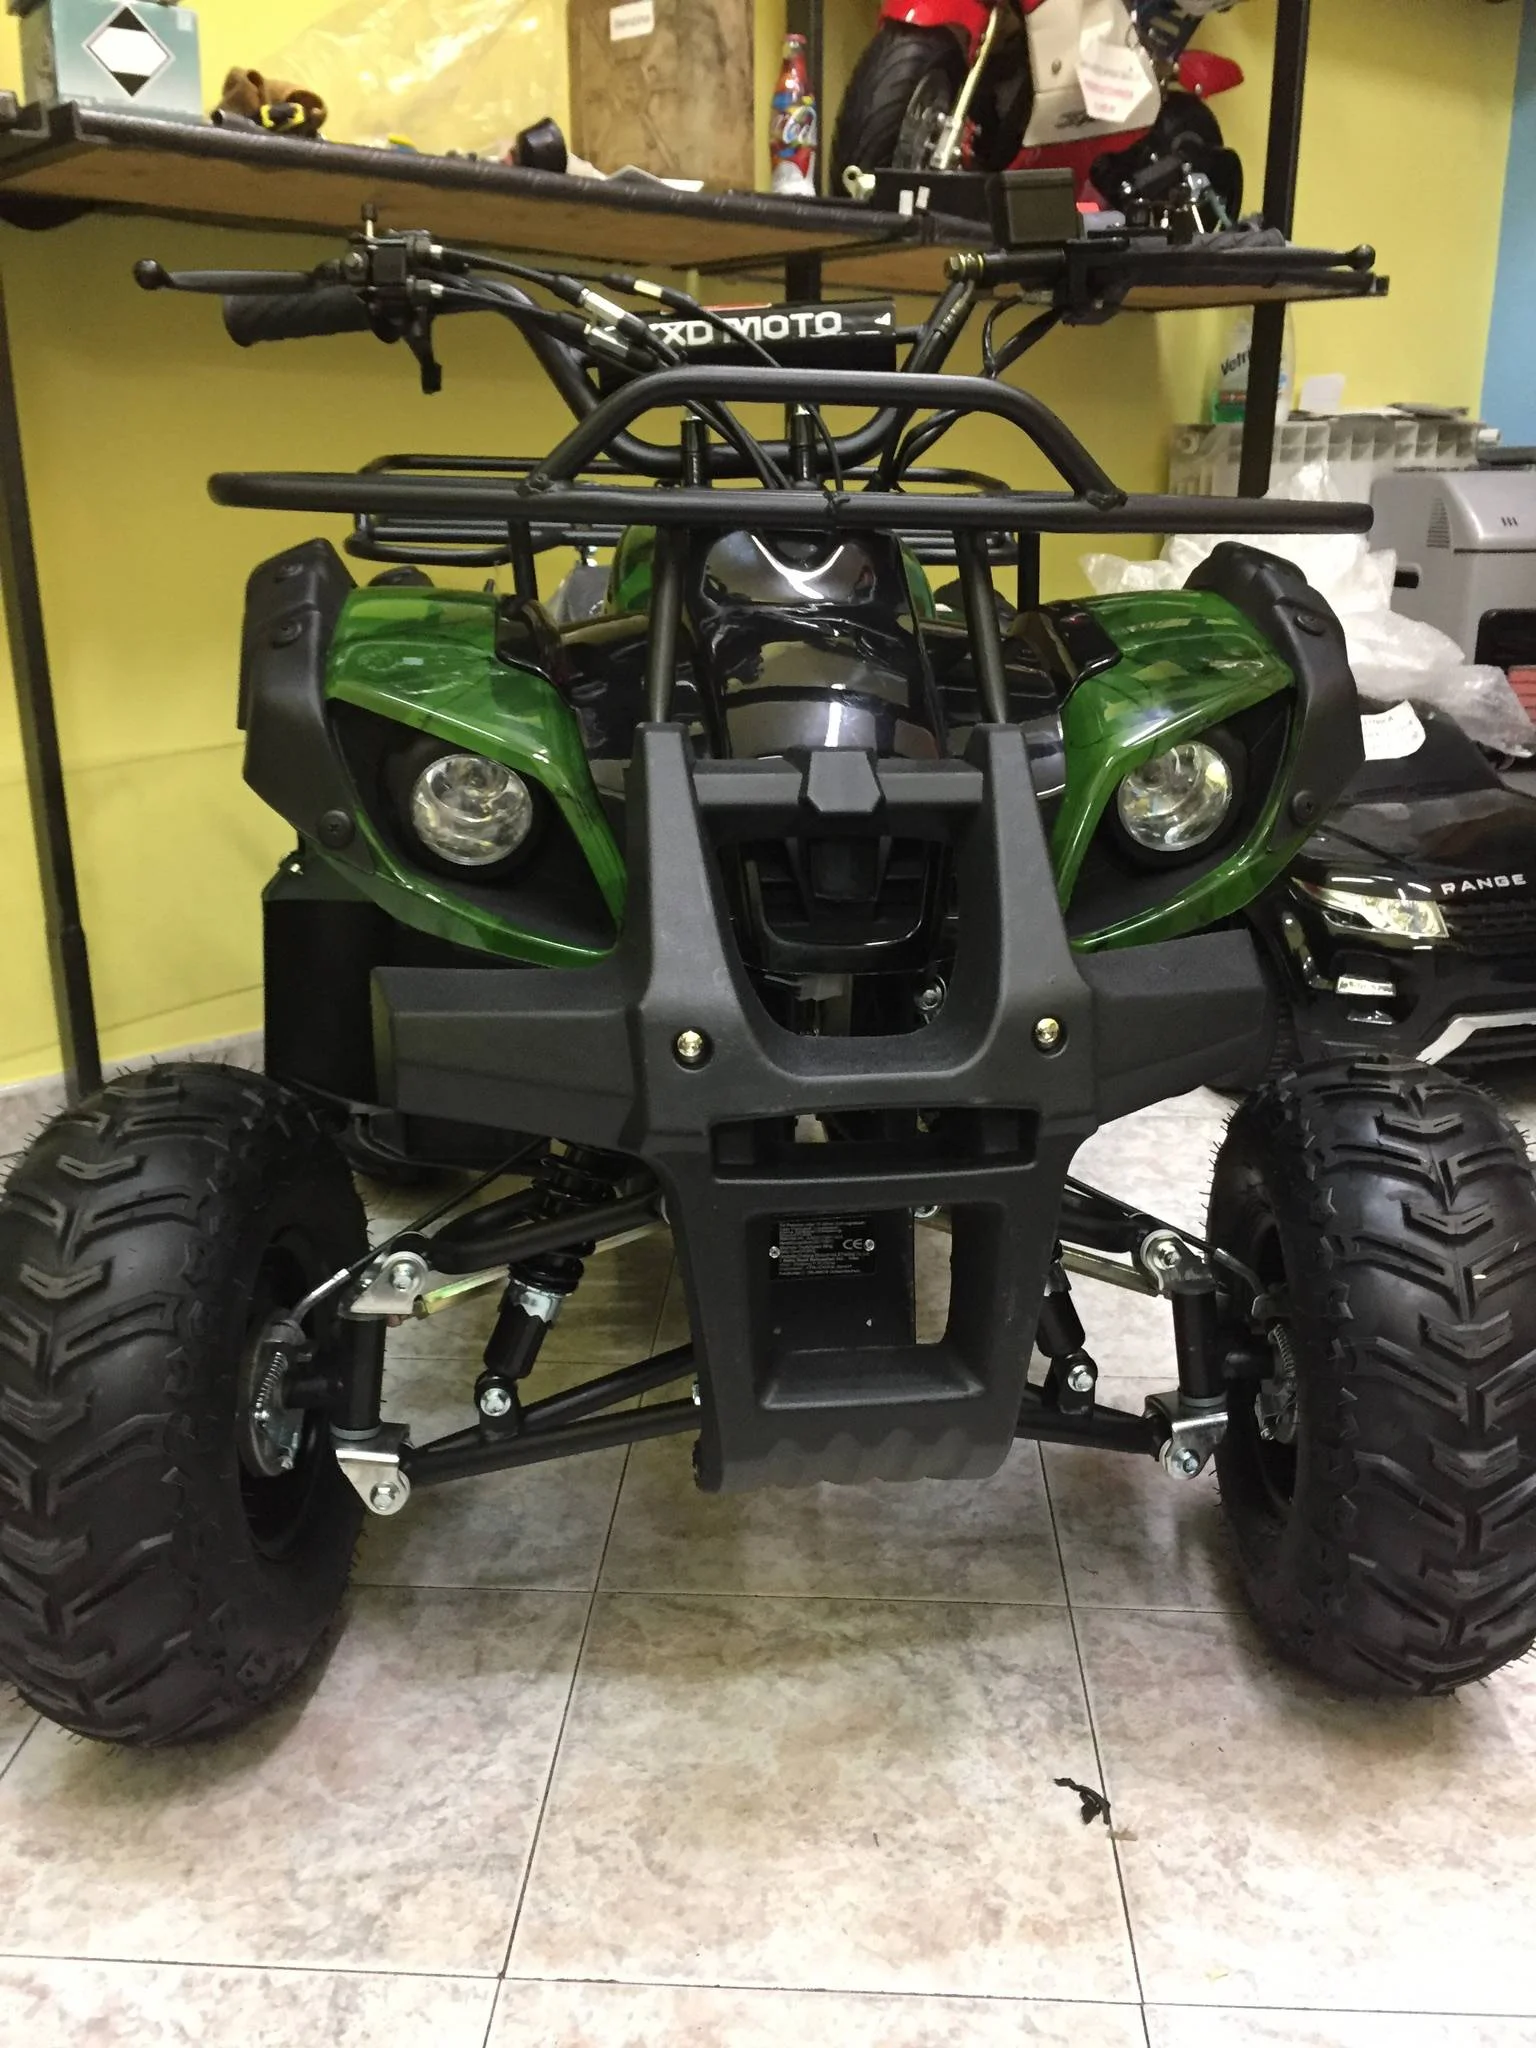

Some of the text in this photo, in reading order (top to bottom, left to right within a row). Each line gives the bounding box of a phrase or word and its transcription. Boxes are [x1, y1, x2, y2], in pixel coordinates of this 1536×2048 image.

[648, 311, 842, 347] XD MOTO
[1440, 873, 1527, 896] RANGE
[842, 1238, 863, 1250] CE
